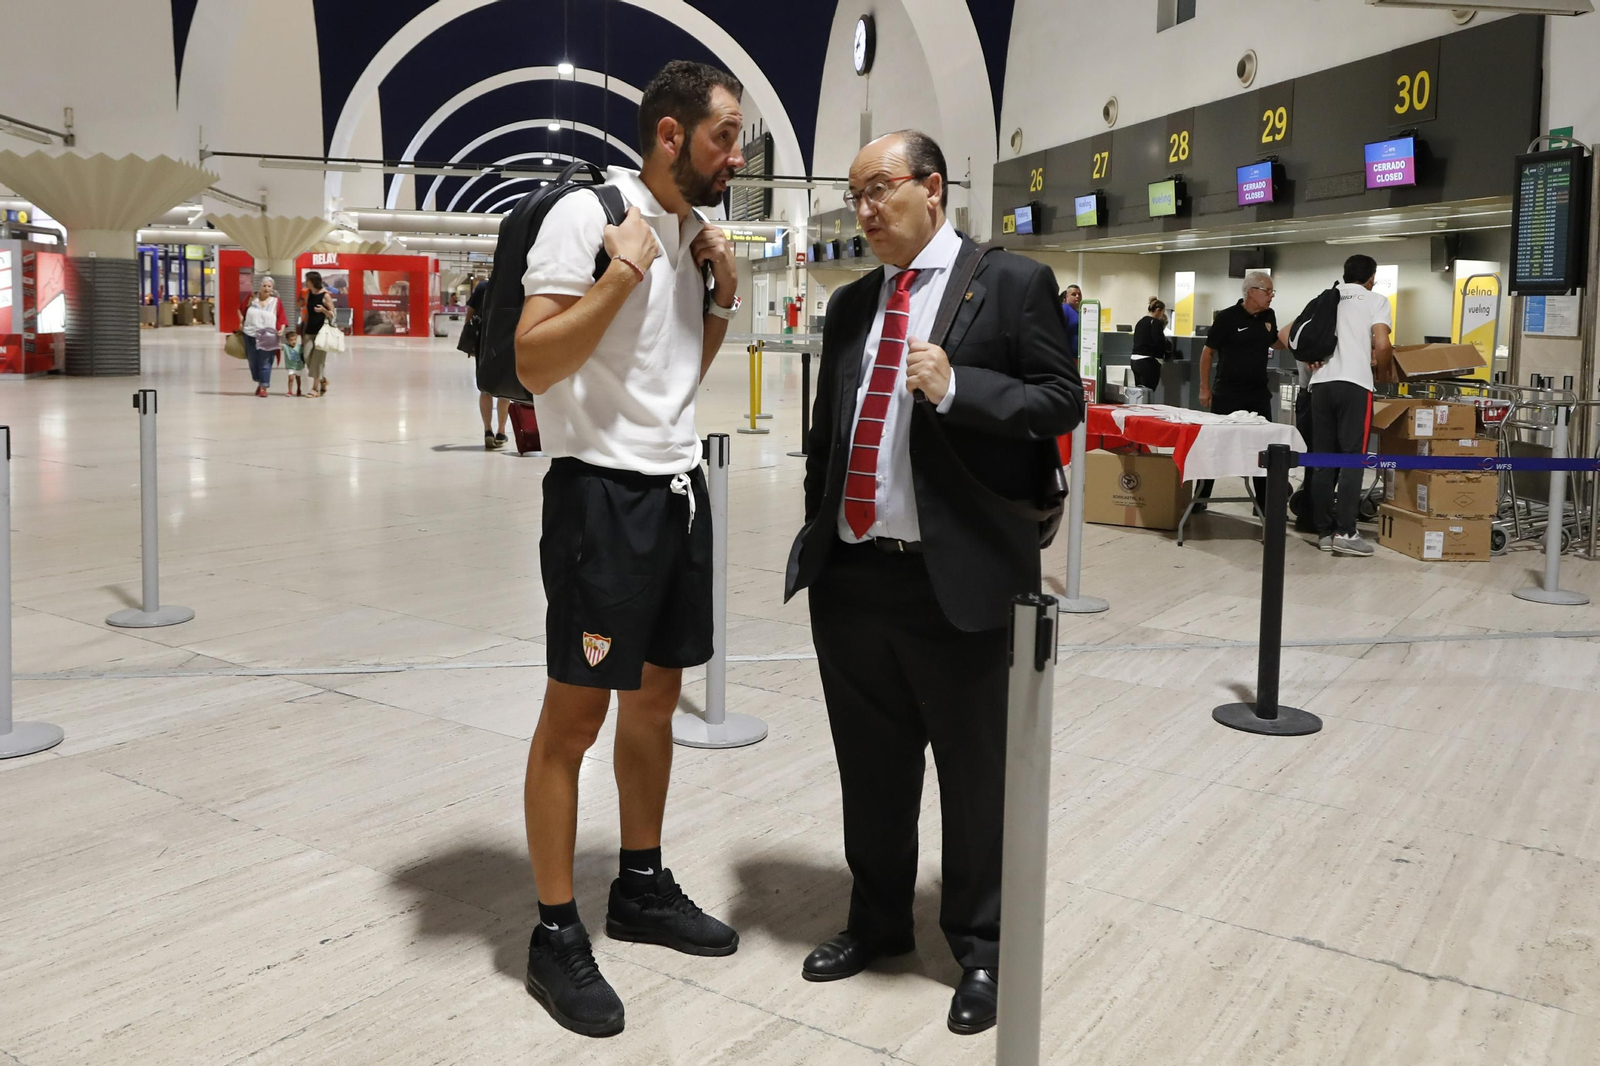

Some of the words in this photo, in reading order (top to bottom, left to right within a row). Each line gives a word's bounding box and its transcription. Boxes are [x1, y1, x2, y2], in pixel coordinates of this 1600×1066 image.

[1394, 70, 1430, 114] 30
[1261, 106, 1287, 144] 29
[1169, 130, 1189, 163] 28
[1093, 151, 1109, 179] 27
[1373, 160, 1406, 172] CERRADO
[1030, 167, 1043, 192] 26
[1376, 172, 1404, 183] CLOSED
[1243, 180, 1266, 191] CERRADO
[1152, 192, 1172, 206] vueling
[1245, 190, 1265, 200] CLOSED
[312, 253, 337, 266] RELAY
[1468, 304, 1490, 316] vueling
[1380, 461, 1397, 469] WFS
